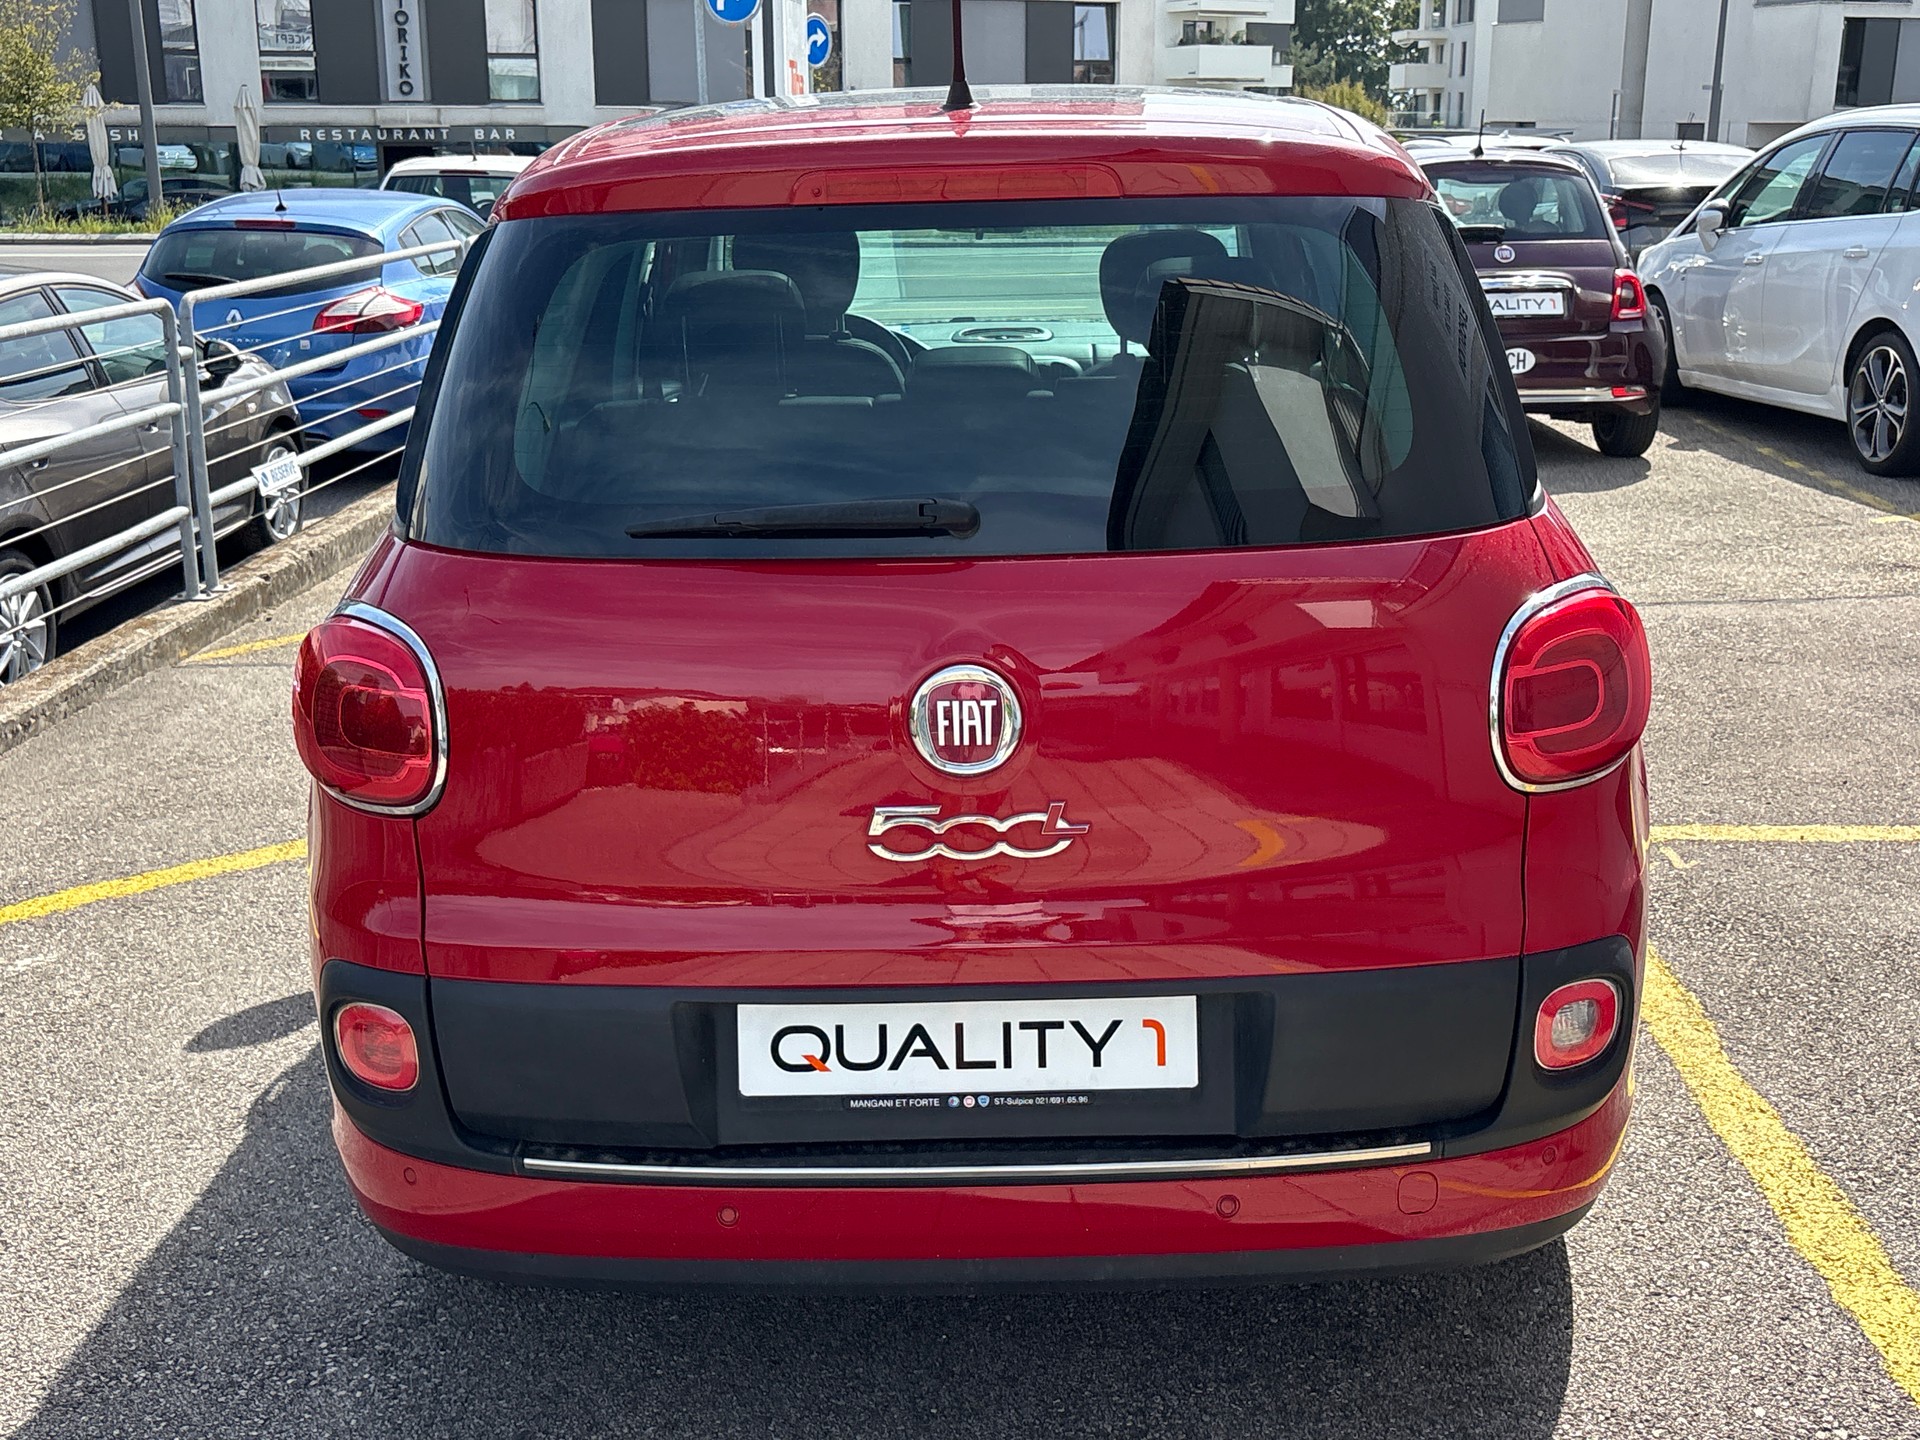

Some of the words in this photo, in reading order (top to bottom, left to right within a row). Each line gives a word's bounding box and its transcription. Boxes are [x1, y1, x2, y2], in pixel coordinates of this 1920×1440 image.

[300, 127, 450, 141] RESTAURANT
[474, 127, 516, 140] BAR
[1488, 298, 1546, 311] ALITY
[936, 699, 998, 747] FIAT
[770, 1019, 1124, 1074] QUALITY
[1142, 1018, 1167, 1067] 1
[850, 1099, 894, 1108] MANGANI
[895, 1098, 907, 1108] ET
[909, 1097, 941, 1107] FORTE
[993, 1096, 1034, 1107] ST-Sulpice
